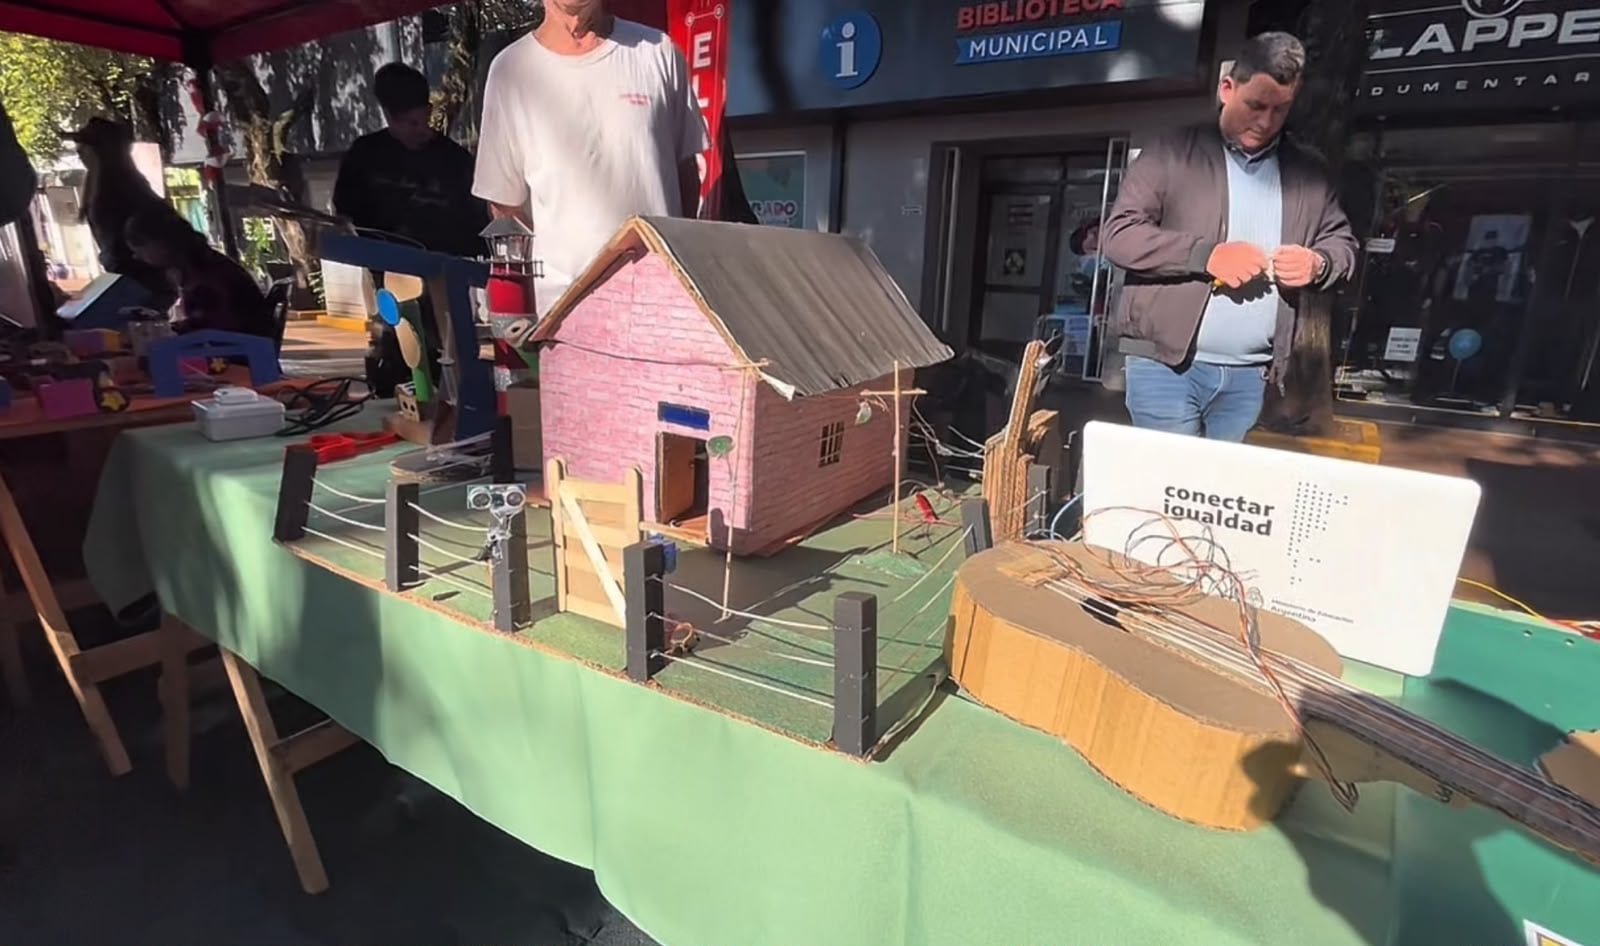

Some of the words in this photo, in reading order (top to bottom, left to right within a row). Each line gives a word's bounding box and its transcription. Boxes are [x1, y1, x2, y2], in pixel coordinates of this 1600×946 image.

[969, 26, 1108, 59] MUNICIPAL
[1163, 498, 1273, 537] igualdad
[1164, 485, 1276, 517] conectar
